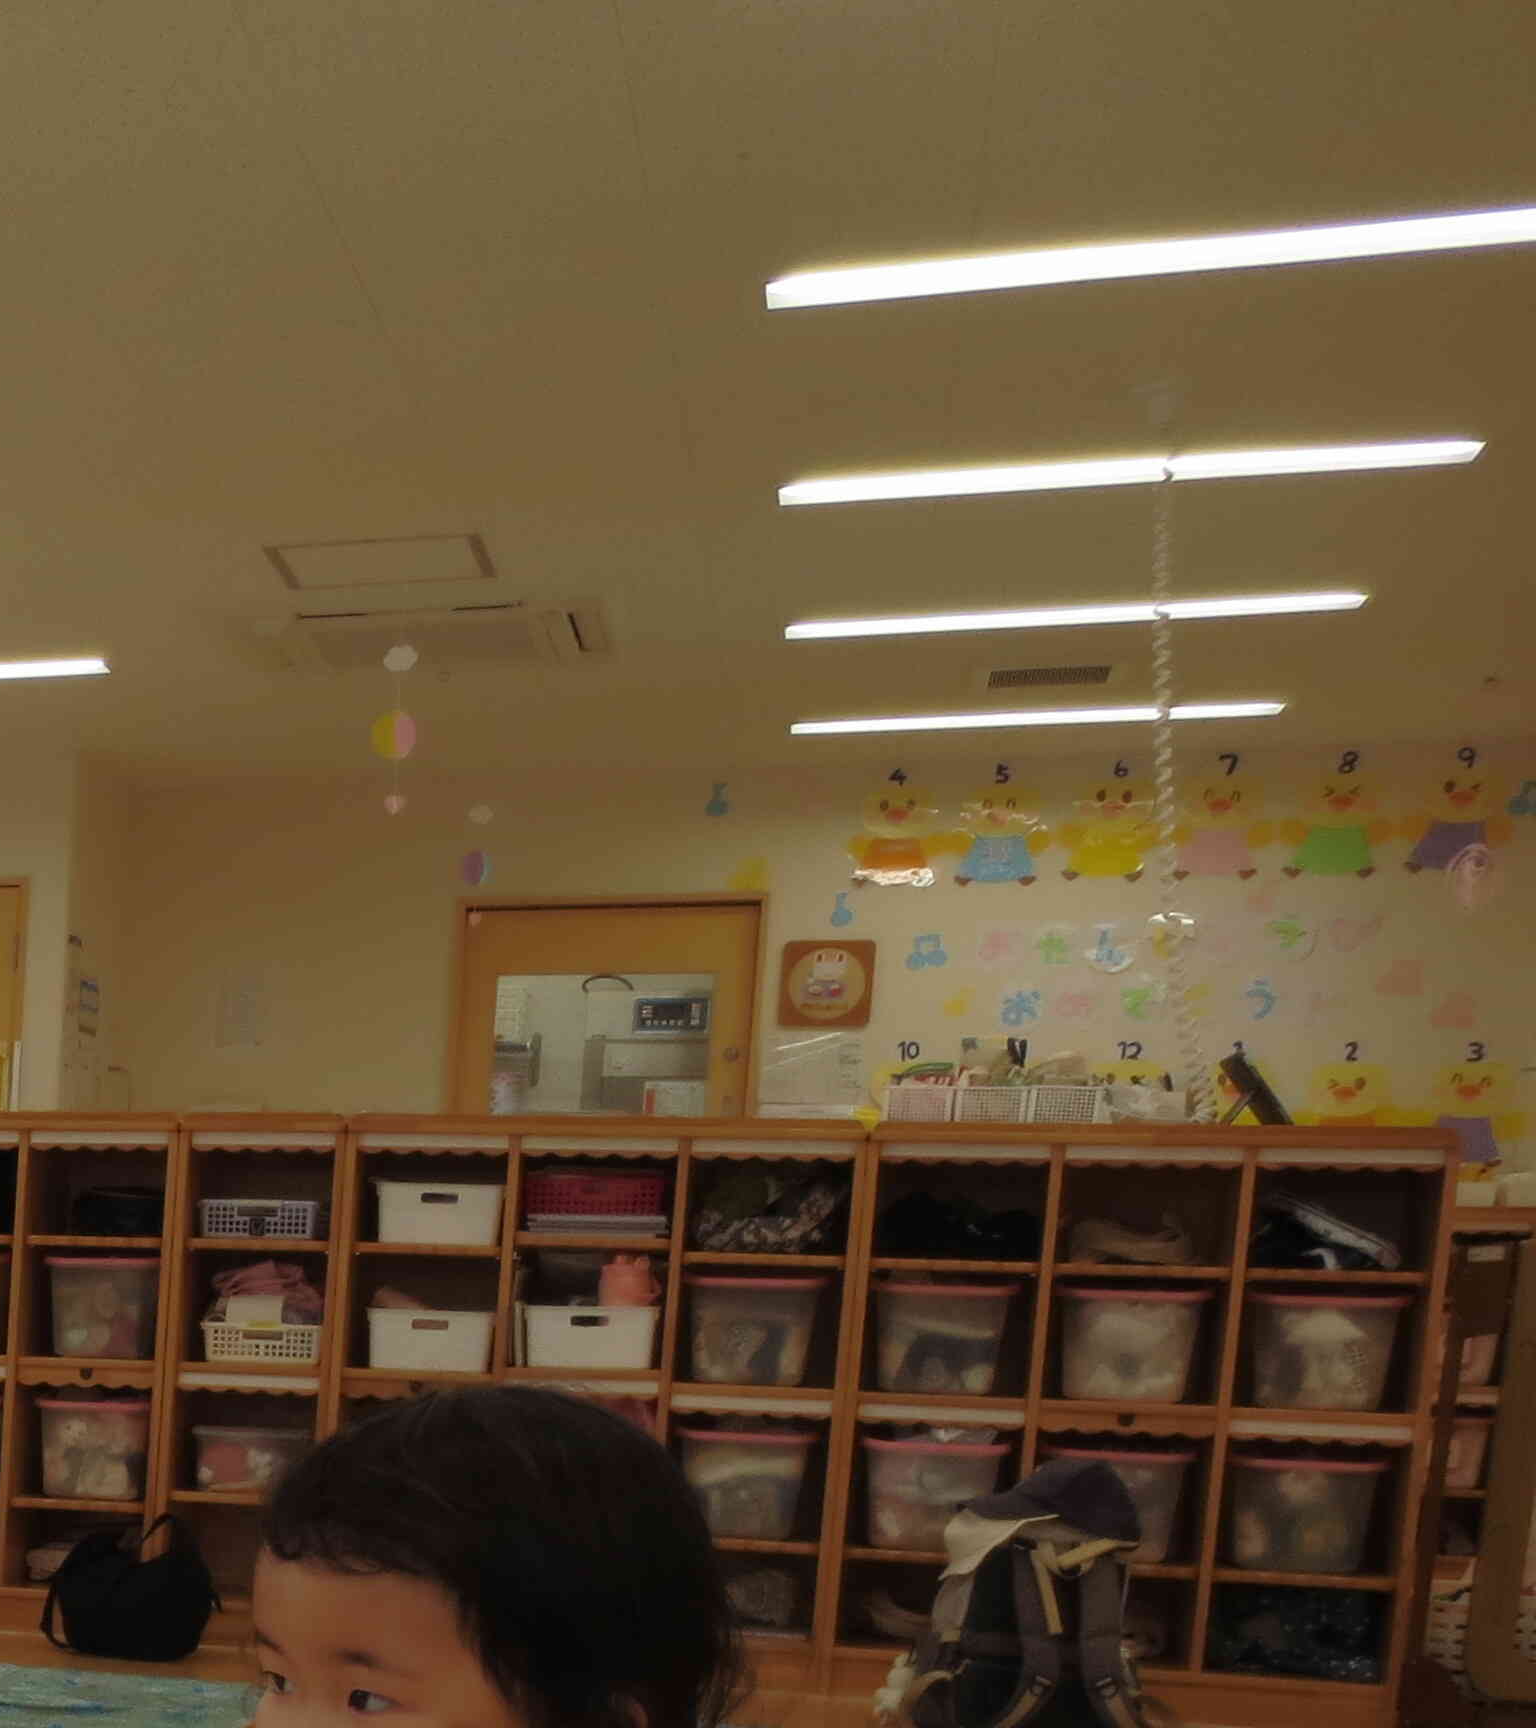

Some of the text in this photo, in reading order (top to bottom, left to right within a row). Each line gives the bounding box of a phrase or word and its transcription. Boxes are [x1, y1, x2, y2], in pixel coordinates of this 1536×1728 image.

[1114, 759, 1129, 778] 6
[1219, 752, 1239, 777] 7
[1338, 751, 1359, 775] 8
[1457, 746, 1477, 769] 9
[888, 767, 908, 786] 4
[994, 763, 1010, 785] 5
[897, 1040, 920, 1063] 10
[1116, 1041, 1143, 1061] 12
[1344, 1041, 1360, 1063] 2
[1466, 1041, 1486, 1063] 3
